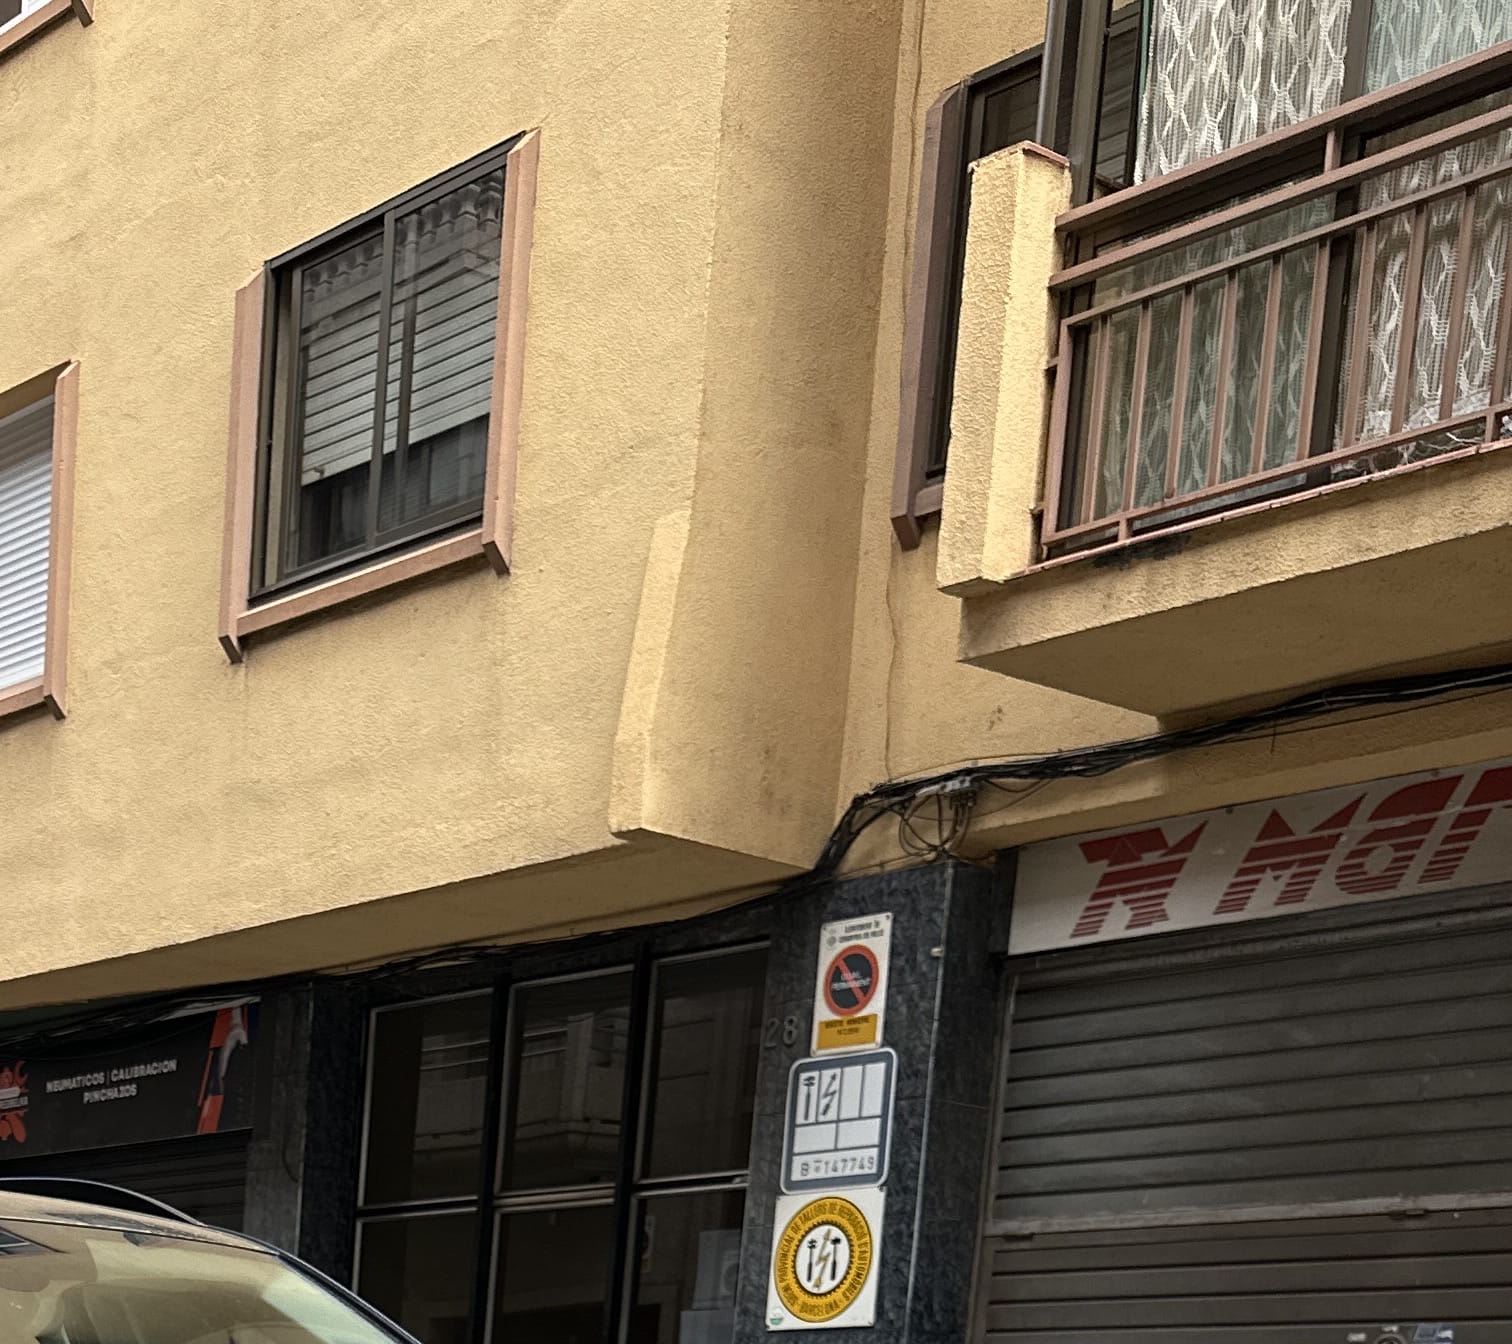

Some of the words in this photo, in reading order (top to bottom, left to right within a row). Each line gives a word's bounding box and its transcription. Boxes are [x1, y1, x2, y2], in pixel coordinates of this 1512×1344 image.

[764, 1016, 798, 1046] 28
[111, 1059, 178, 1082] CALIBRACION
[83, 1084, 137, 1104] PINCHAZOS
